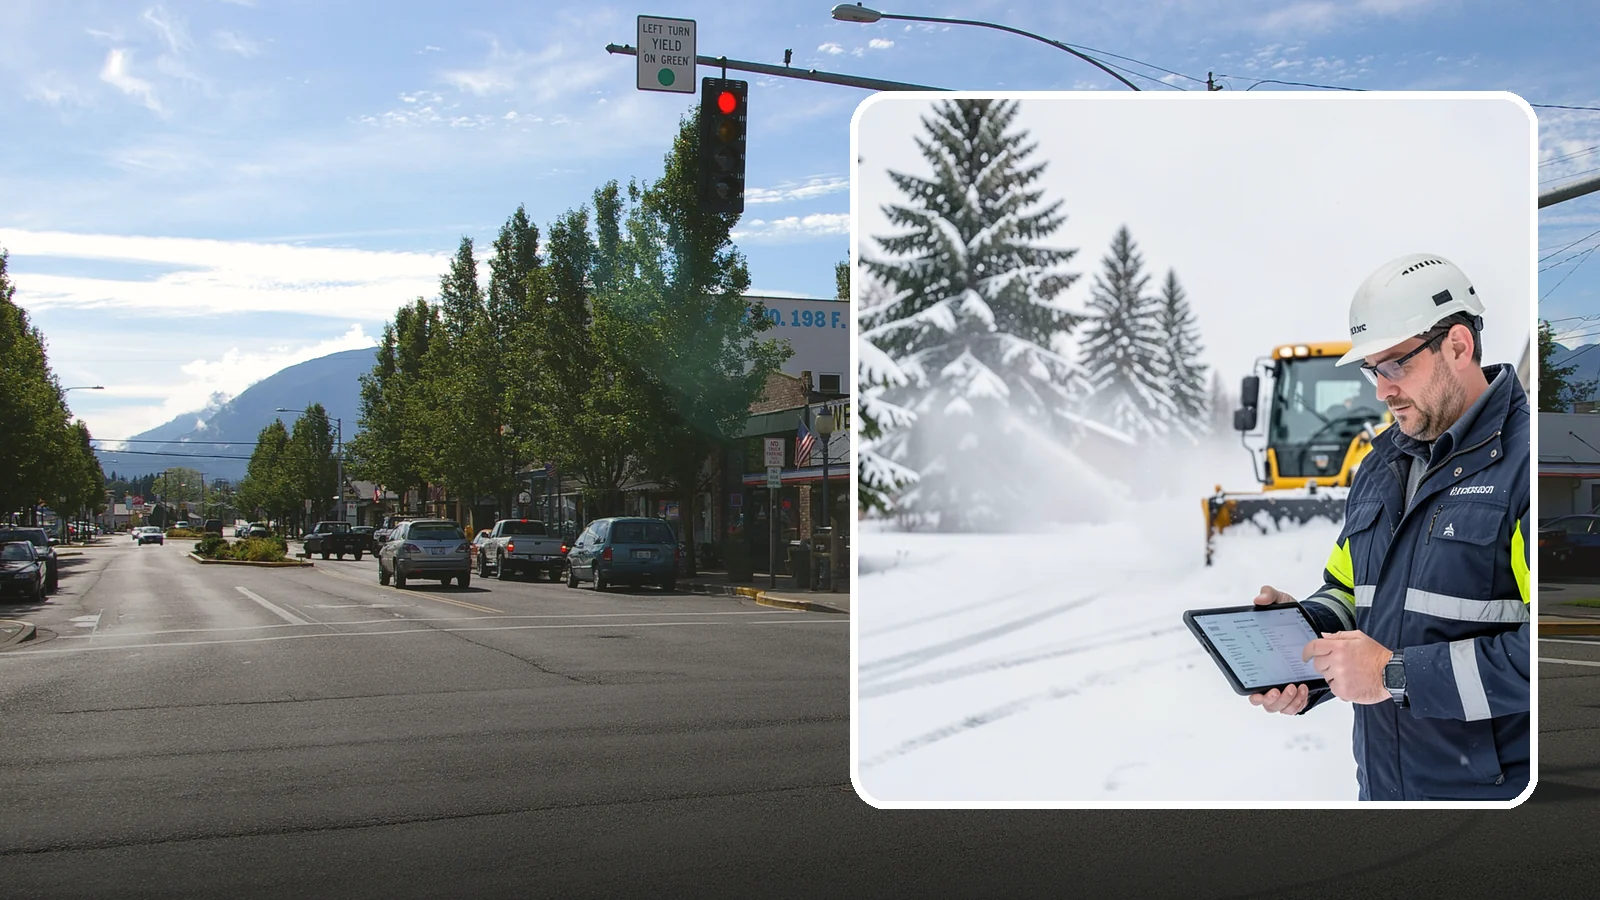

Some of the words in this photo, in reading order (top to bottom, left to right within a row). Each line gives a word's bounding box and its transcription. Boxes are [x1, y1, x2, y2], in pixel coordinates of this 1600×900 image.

[643, 24, 663, 34] LEFT
[668, 25, 690, 36] TURN
[652, 38, 682, 51] YIELD
[644, 53, 656, 63] ON
[661, 55, 689, 66] GREEN
[791, 309, 826, 328] 198
[831, 311, 846, 329] F.
